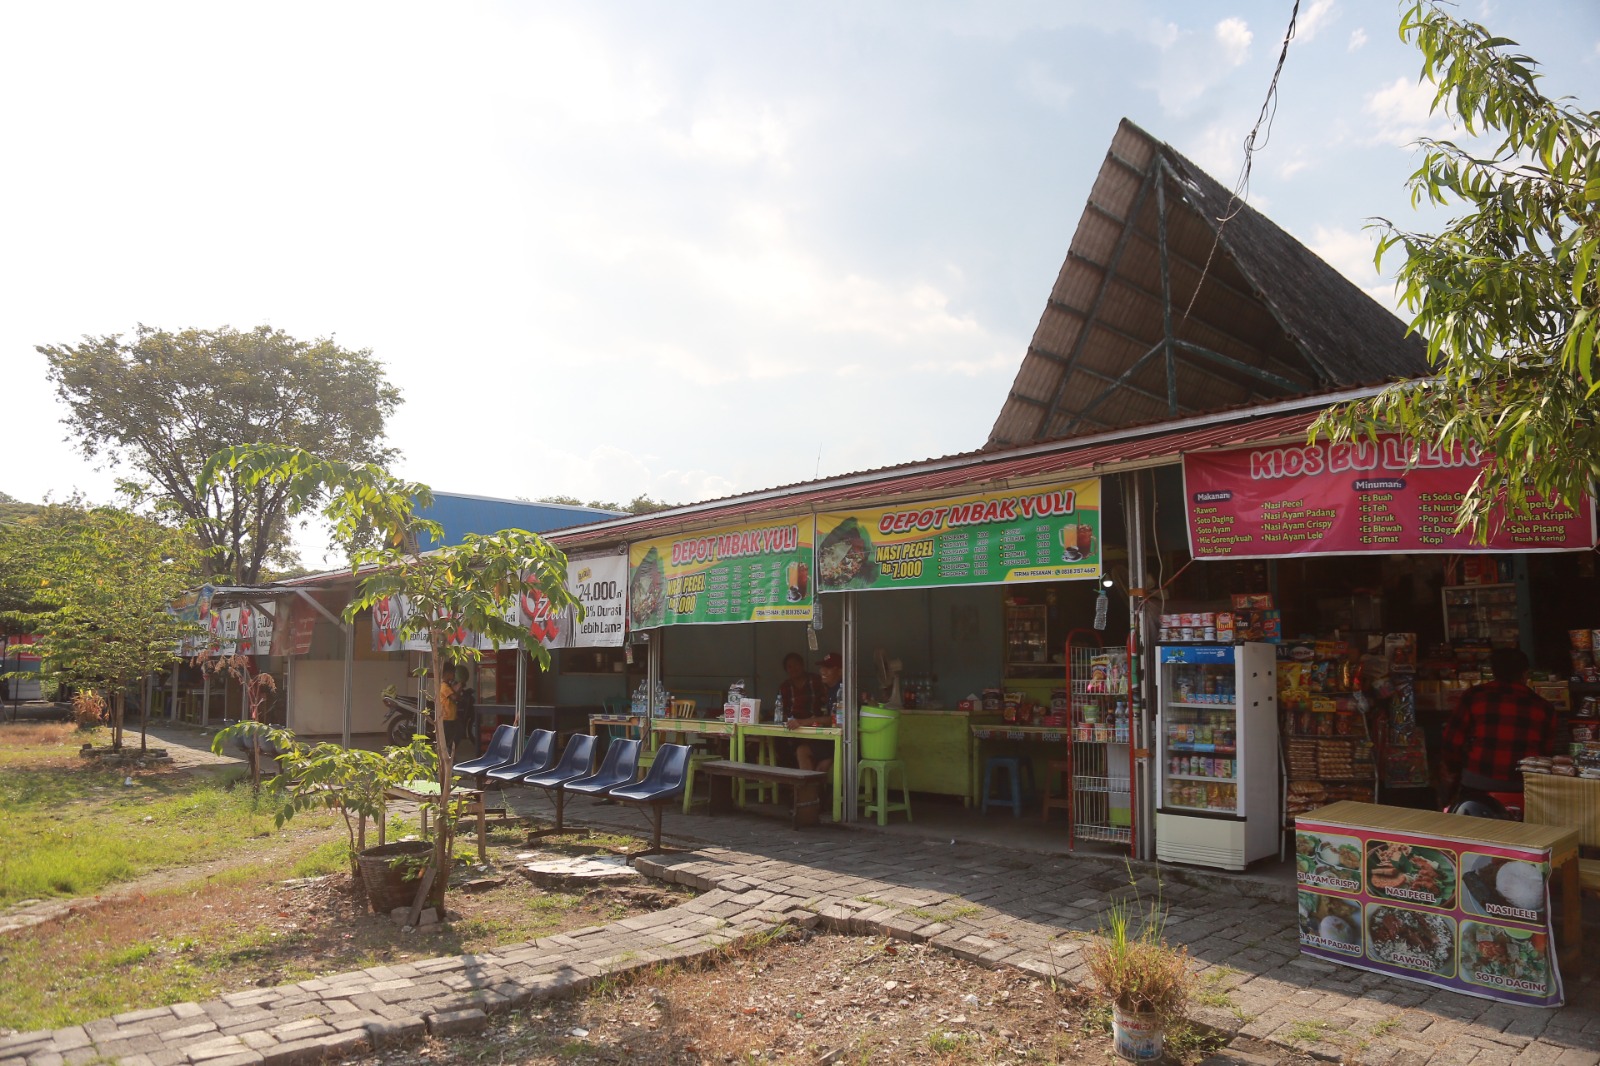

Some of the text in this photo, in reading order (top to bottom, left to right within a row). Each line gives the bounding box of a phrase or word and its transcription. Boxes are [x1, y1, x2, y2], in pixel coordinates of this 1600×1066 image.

[1250, 446, 1325, 480] KIOS
[1328, 440, 1378, 474] BU
[1362, 493, 1393, 502] Es Buah
[1433, 493, 1452, 501] Soda
[1264, 500, 1303, 510] Nasi Pecel
[1373, 504, 1388, 512] Teh
[878, 489, 1075, 534] DEPOT MBAK YULI
[1264, 509, 1335, 520] Nasi Ayam Padang
[1543, 510, 1573, 521] Kripik
[1197, 515, 1234, 525] Soto Daging
[1373, 514, 1395, 522] Jeruk
[1423, 515, 1439, 524] Pop
[1213, 526, 1231, 534] Ayam
[1282, 522, 1305, 531] Ayam
[1306, 520, 1332, 529] Crispy
[1363, 524, 1402, 533] Es Blewah
[1423, 525, 1432, 533] Es
[1511, 524, 1565, 534] Sele Pisang
[1264, 531, 1323, 542] Nasi Ayam Lele
[1373, 535, 1399, 543] Tomat
[1423, 536, 1443, 544] Kopi
[672, 524, 798, 567] DEPOT MBAK YULI
[875, 539, 934, 563] NASI PECEL
[1201, 546, 1213, 554] Nasi
[892, 559, 923, 579] 7.000
[682, 573, 706, 594] PECEL
[597, 604, 622, 618] Durasi
[1305, 873, 1328, 884] AYAM
[1329, 878, 1359, 889] CRISPY
[1386, 887, 1436, 902] NASI PECEL
[1486, 903, 1537, 920] NASI LELE
[1306, 933, 1327, 945] AYAM
[1327, 940, 1360, 953] PADANG
[1392, 953, 1430, 968] RAWON
[1475, 971, 1504, 985] SOTO
